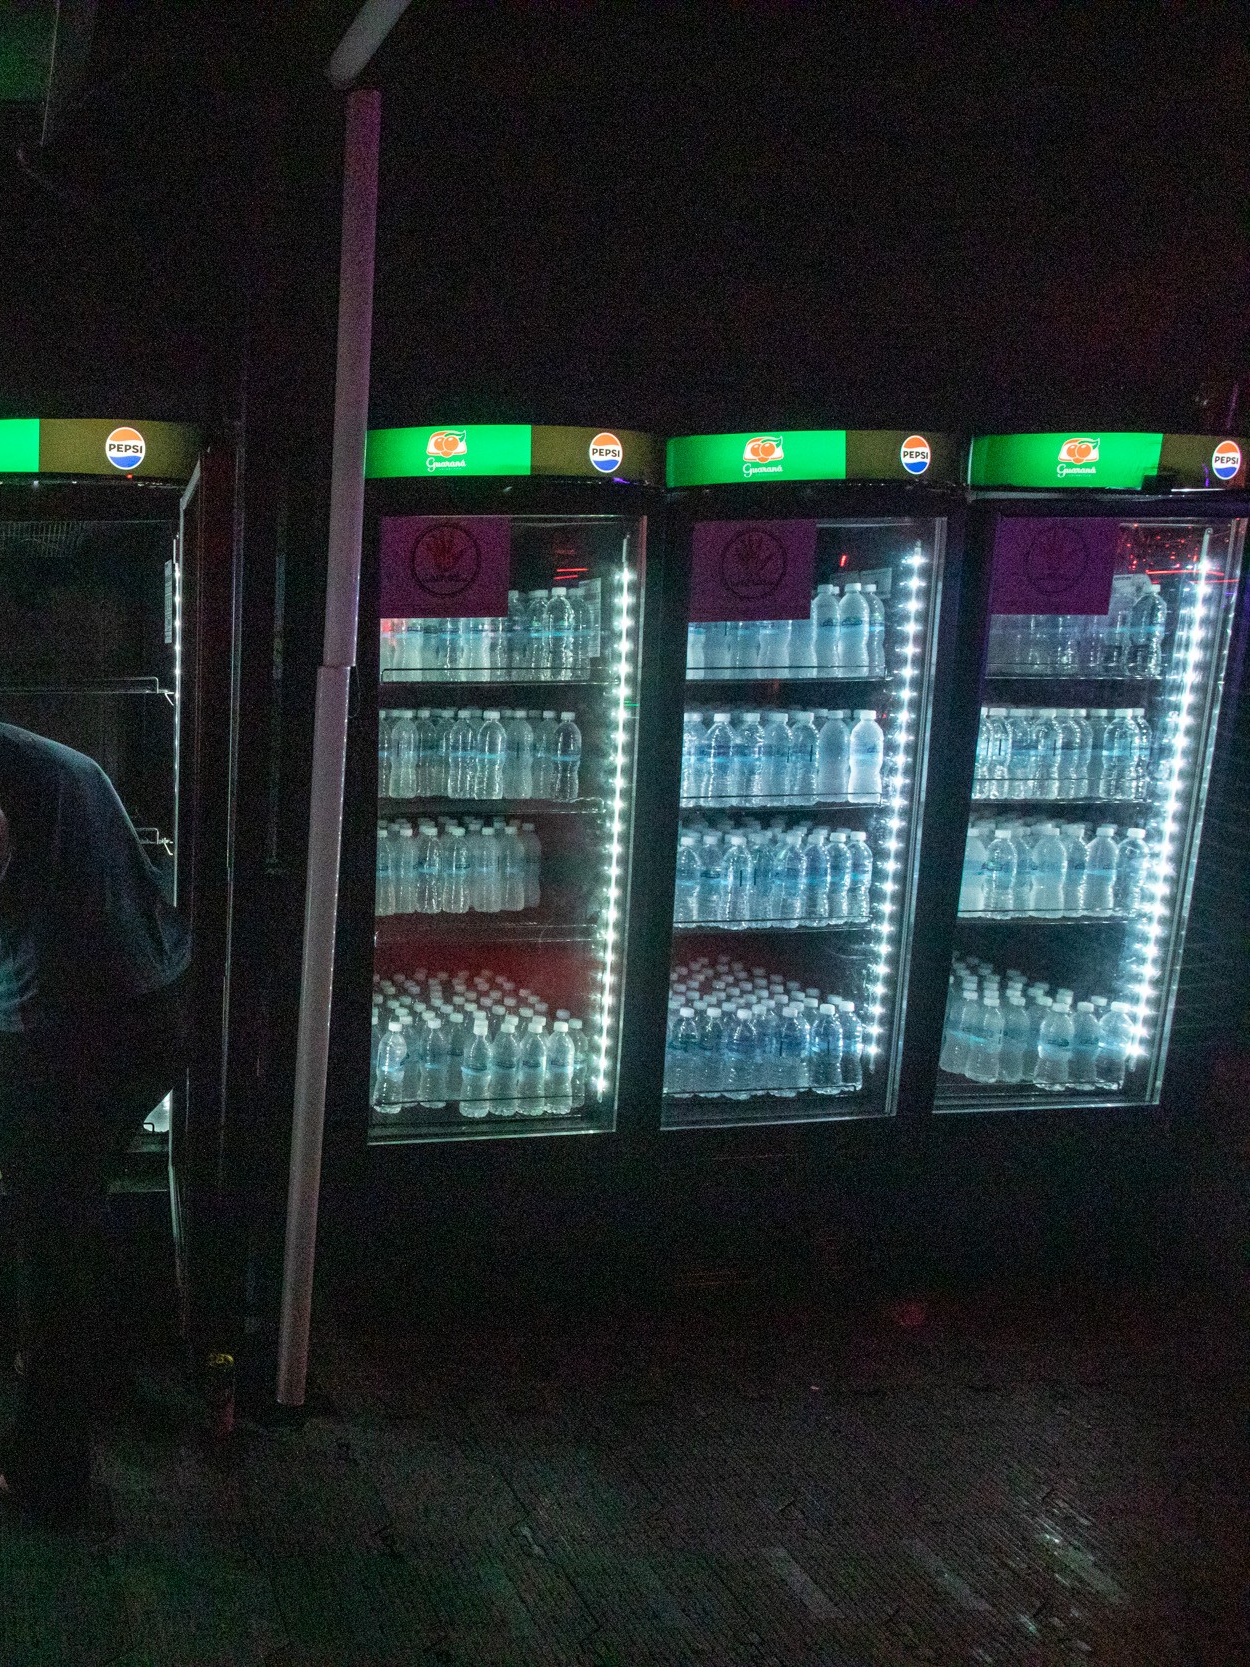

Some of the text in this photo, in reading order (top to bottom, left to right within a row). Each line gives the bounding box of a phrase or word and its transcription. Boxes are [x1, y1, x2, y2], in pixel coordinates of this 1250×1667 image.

[107, 443, 143, 454] PEPSI
[591, 448, 621, 457] PEPSI
[902, 450, 928, 460] PEPSI
[1214, 456, 1239, 465] PEPSI
[426, 457, 466, 472] Guaraná
[743, 463, 783, 477] Guaraná
[1057, 463, 1096, 478] Guaraná
